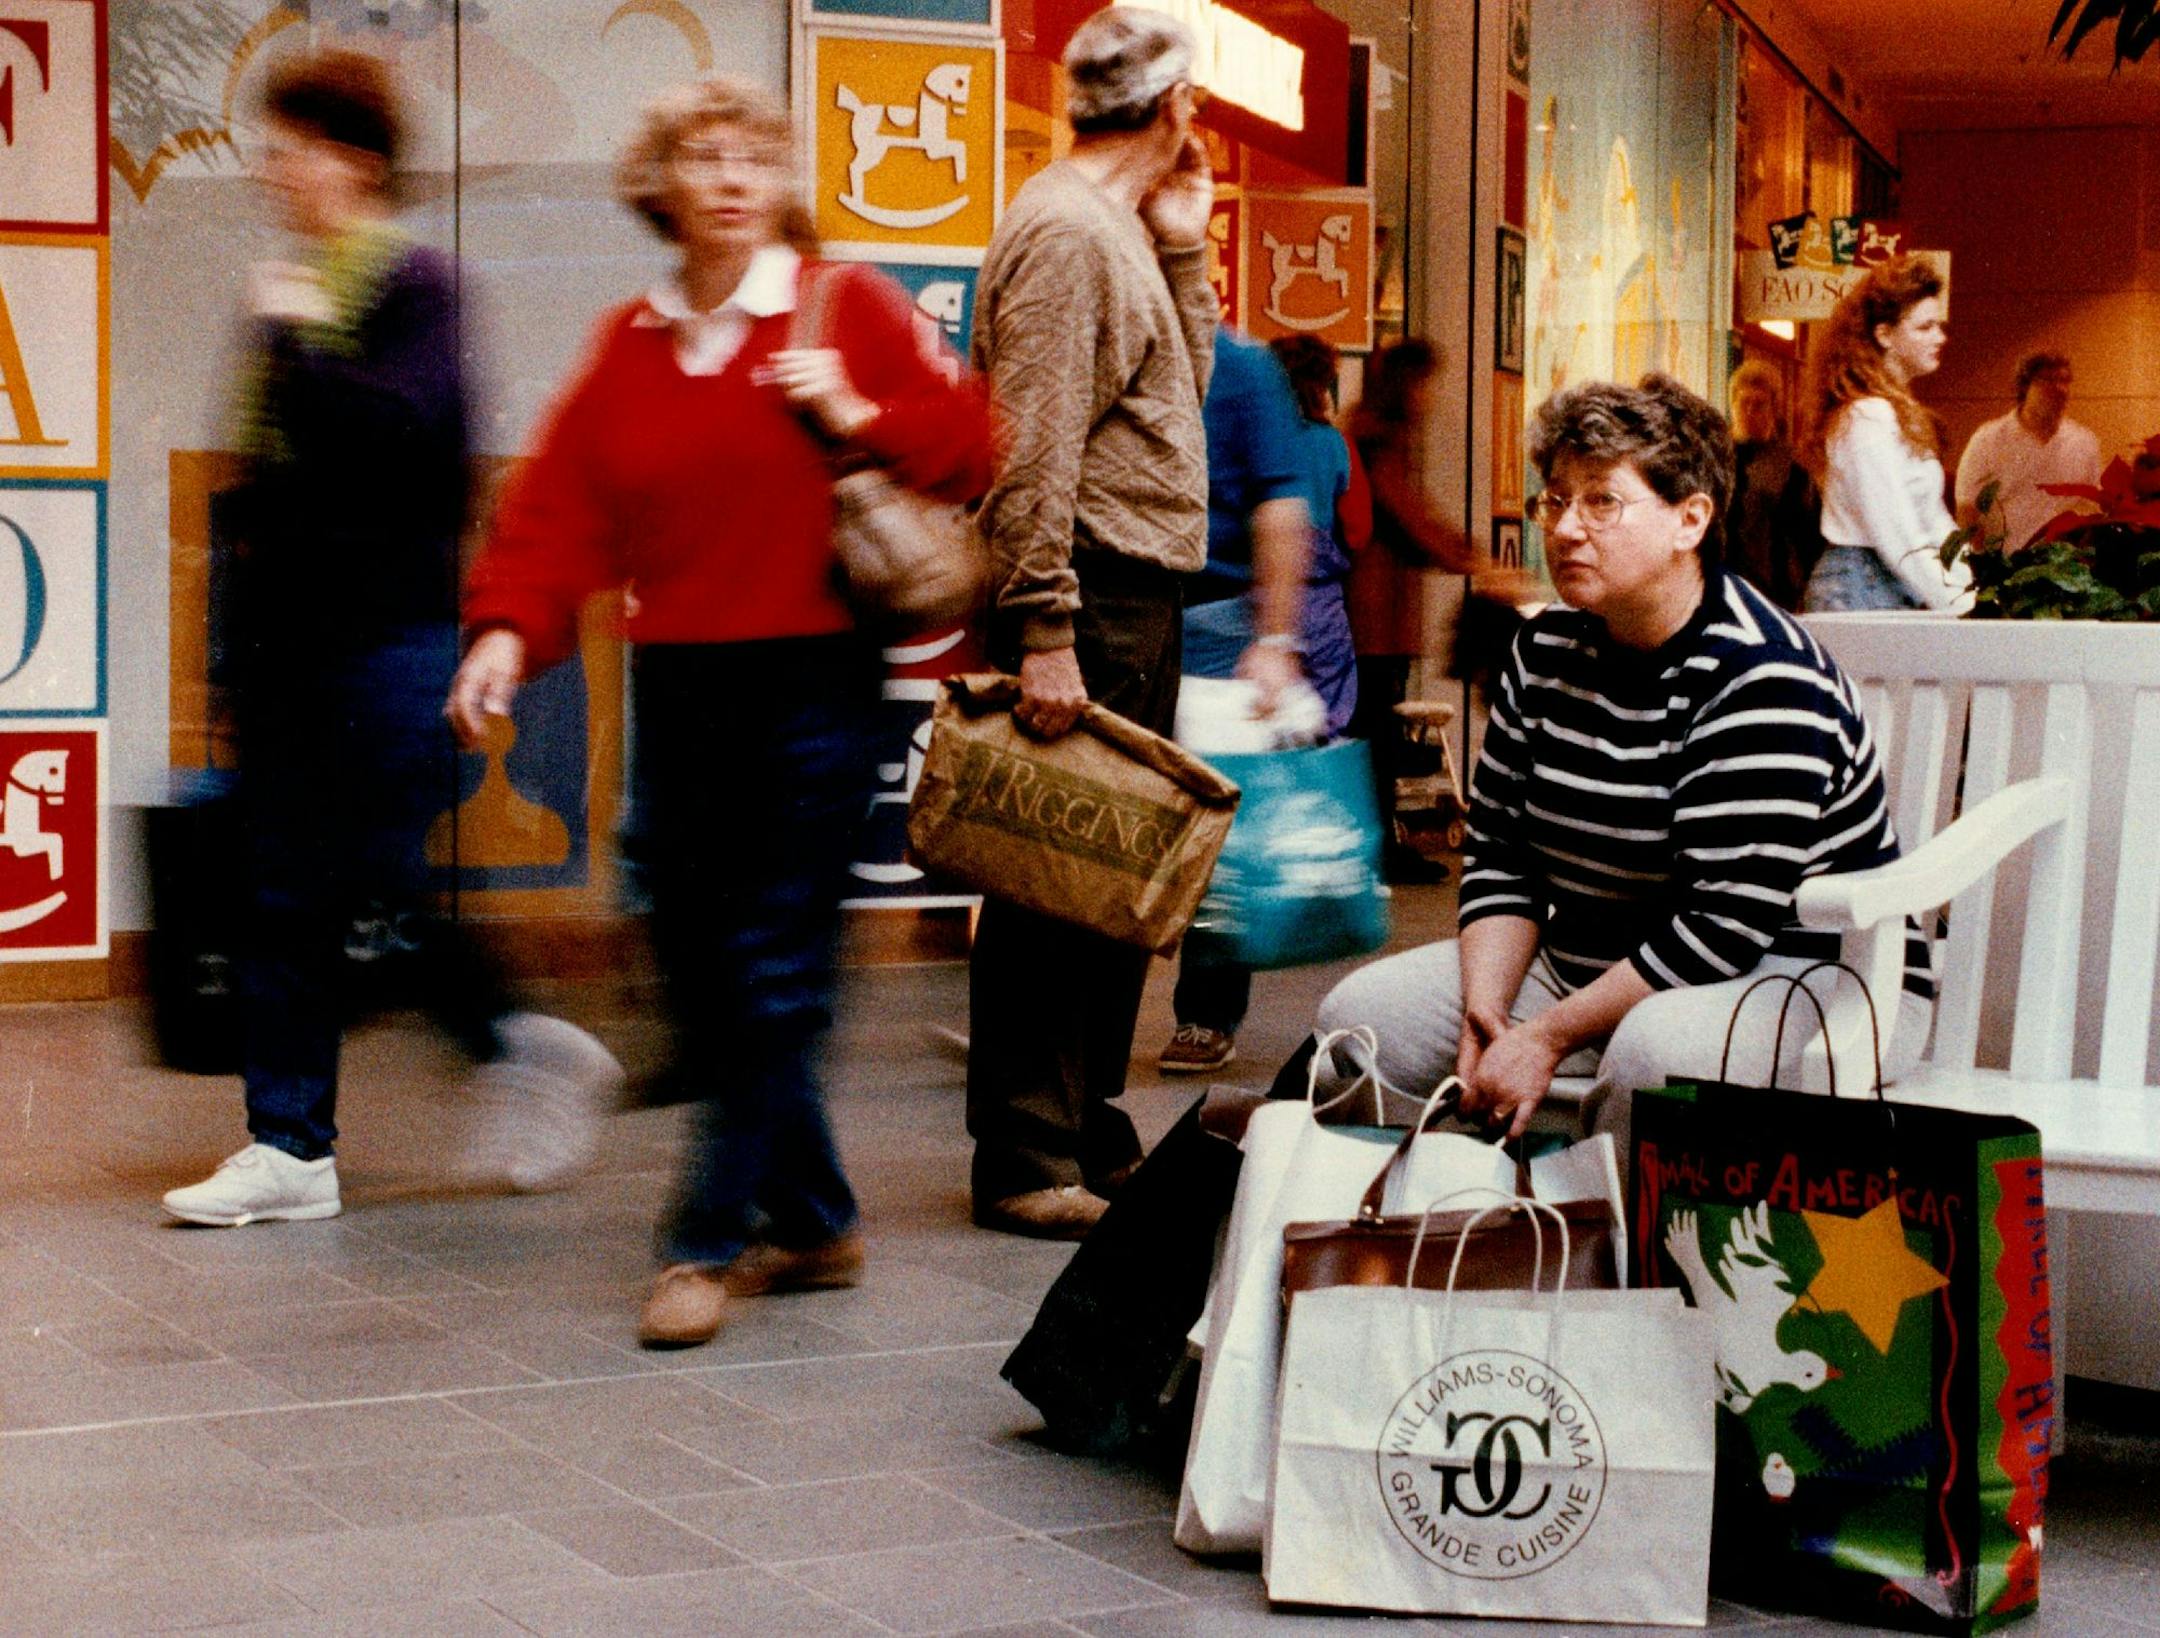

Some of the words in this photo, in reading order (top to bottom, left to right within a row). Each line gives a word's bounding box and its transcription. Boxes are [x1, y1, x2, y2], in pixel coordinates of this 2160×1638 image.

[1761, 276, 1814, 303] FAO
[1723, 1161, 1761, 1196] OF
[1388, 1361, 1595, 1471] WILLIAMS-SONOMA
[1390, 1470, 1483, 1567] GRANDE
[1496, 1482, 1592, 1568] CUISINE
